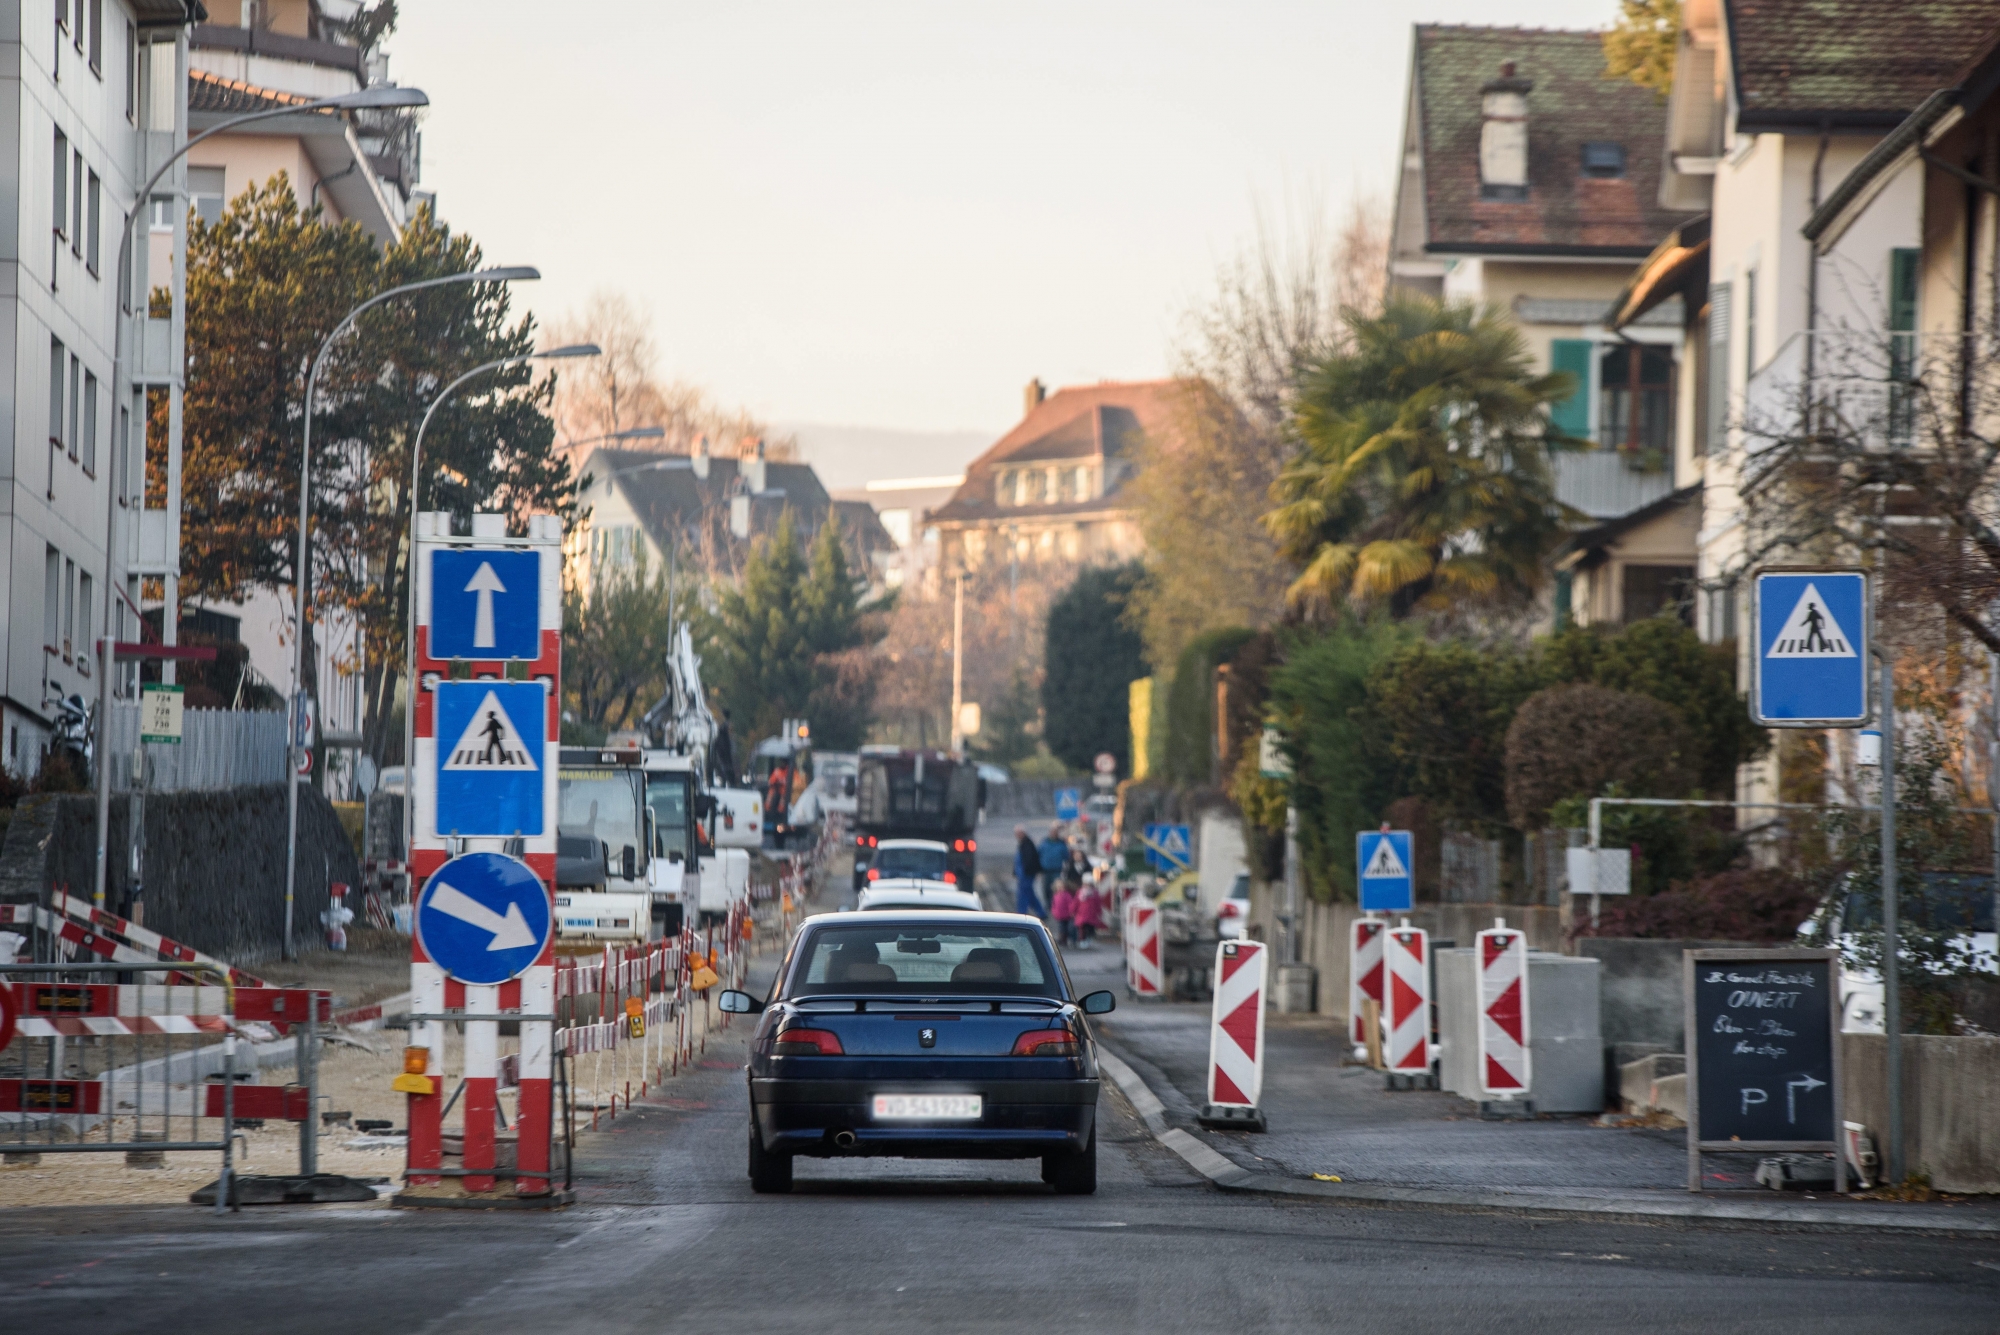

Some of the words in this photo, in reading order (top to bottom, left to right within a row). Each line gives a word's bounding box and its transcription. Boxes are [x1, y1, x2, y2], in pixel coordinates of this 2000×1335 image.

[558, 770, 613, 780] MANAGER
[1727, 990, 1802, 1009] OUVERT
[1740, 1087, 1769, 1116] P
